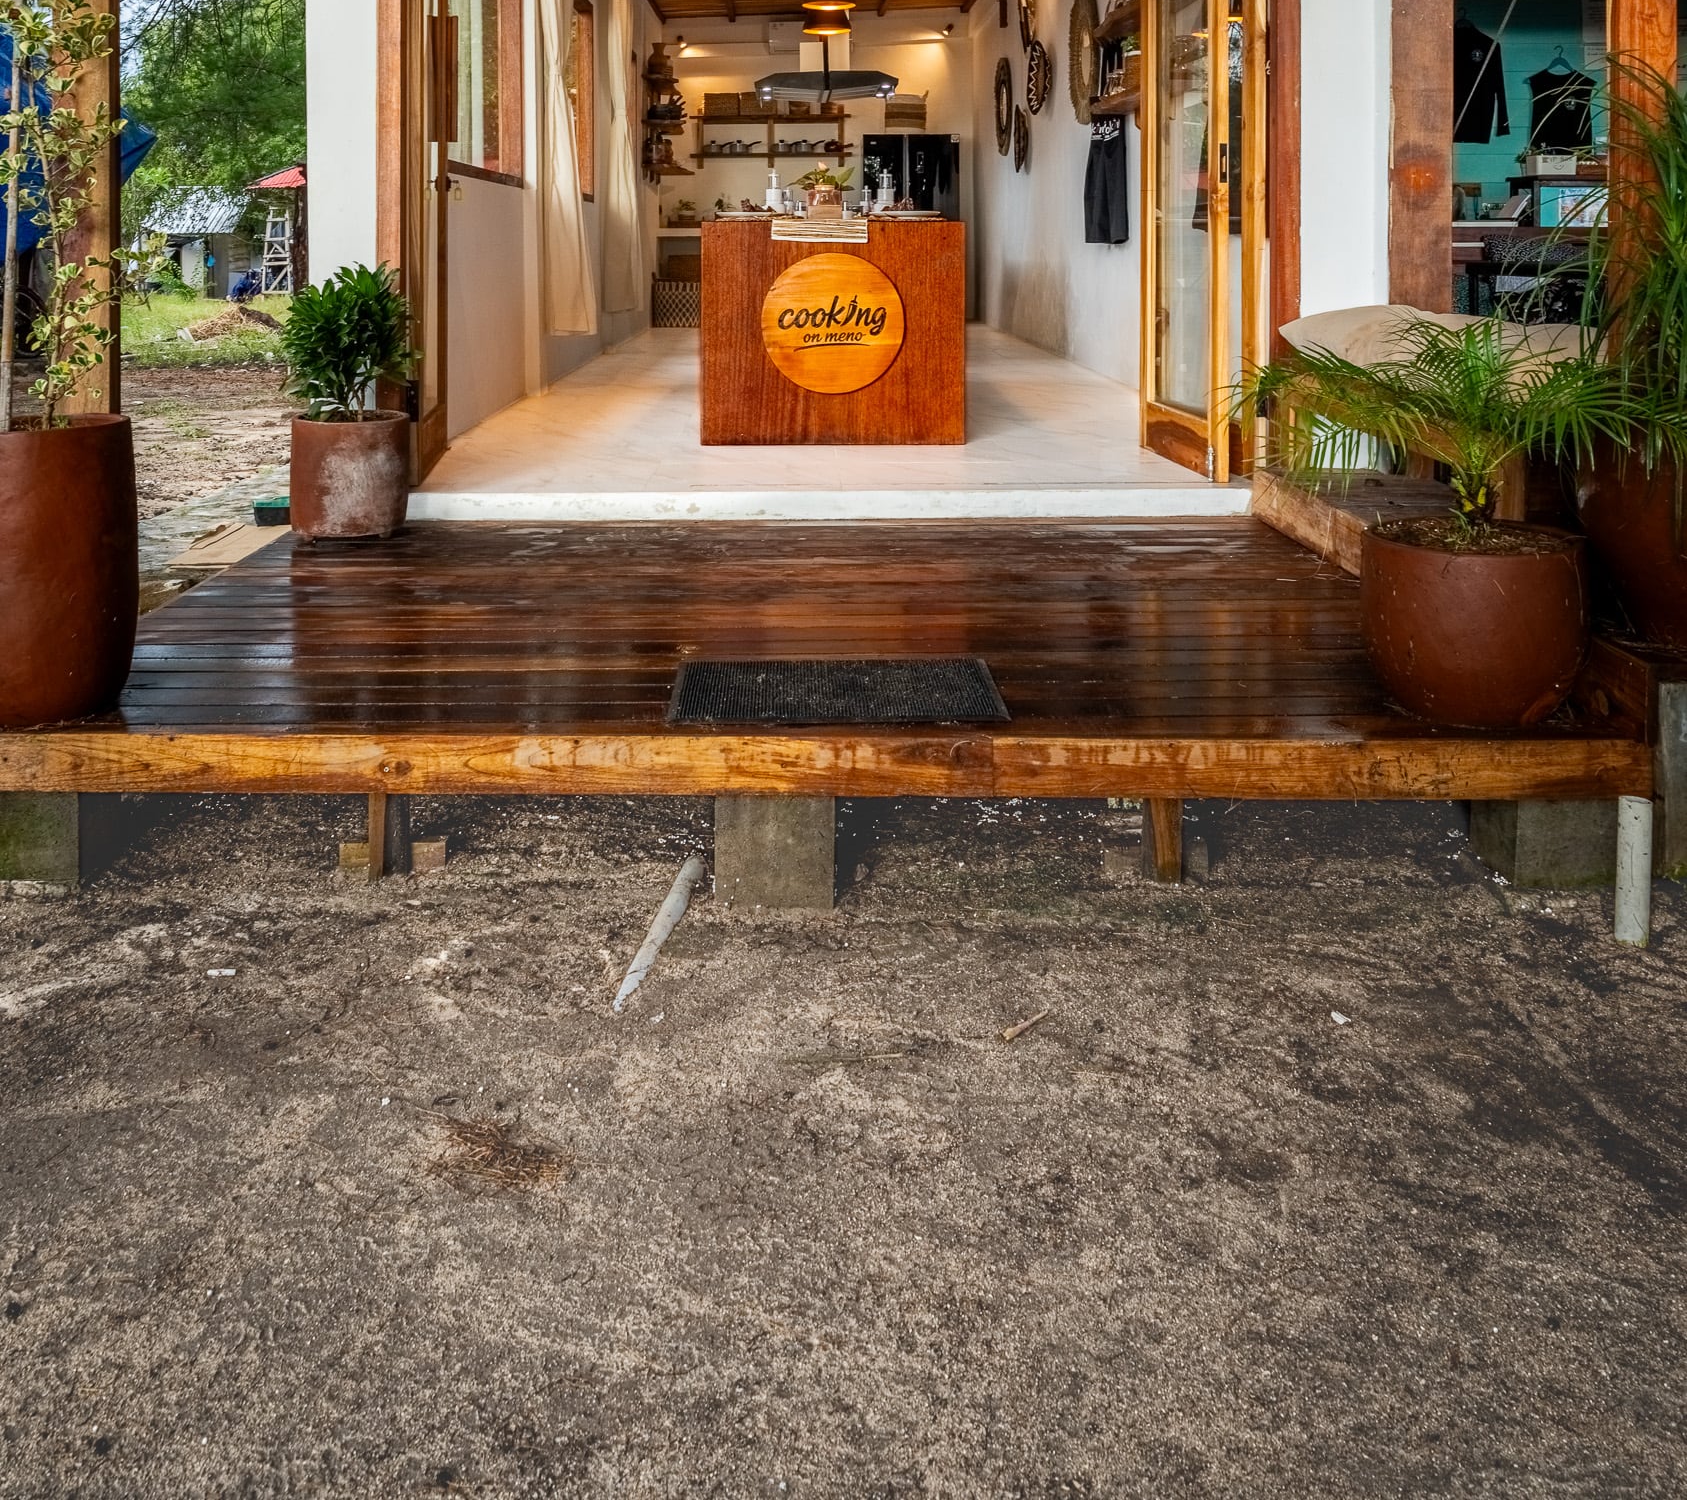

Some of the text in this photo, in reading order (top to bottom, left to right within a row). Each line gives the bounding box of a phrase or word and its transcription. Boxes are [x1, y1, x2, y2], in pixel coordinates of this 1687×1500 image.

[777, 295, 887, 336] cooking
[803, 331, 867, 343] on meno
